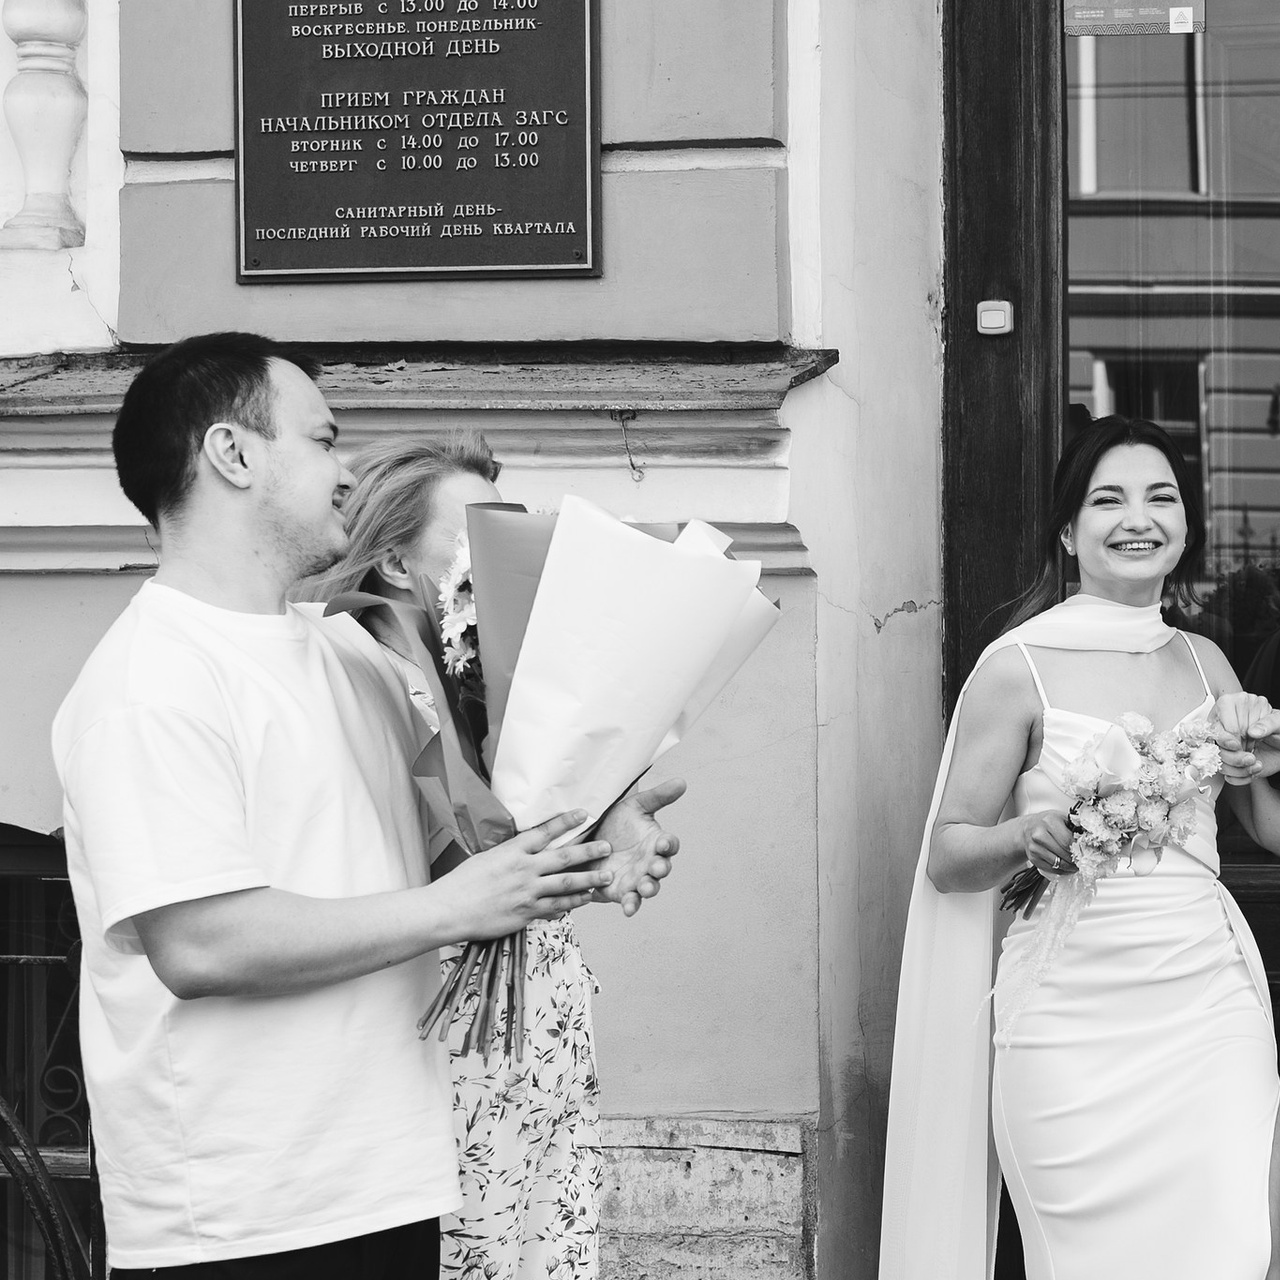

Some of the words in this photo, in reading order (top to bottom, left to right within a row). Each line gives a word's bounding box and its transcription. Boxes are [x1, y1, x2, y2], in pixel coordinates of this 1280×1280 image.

[288, 2, 363, 17] ПЕРЕРЫВ
[322, 36, 434, 59] ВЫХОДНОЙ
[445, 38, 500, 58] ДЕНЬ
[321, 91, 390, 108] ПРИЕМ
[403, 88, 504, 107] ГРАЖДАН
[260, 114, 410, 133] НАЧАЛЬНИКОМ
[421, 111, 503, 130] ОТДЕЛА
[515, 110, 568, 125] ЗАГС
[291, 139, 363, 152] ВТОРНИК
[401, 133, 443, 149] 14.00
[495, 131, 539, 147] 17.00
[289, 159, 358, 173] ЧЕТВЕРГ
[401, 154, 443, 170] 10.00
[494, 152, 539, 167] 13.00
[335, 202, 444, 219] САНИТАРНЫЙ
[255, 223, 350, 241] ПОСЛЕДНИЙ
[360, 222, 431, 238] РАБОЧИЙ
[439, 223, 483, 238] ДЕНЬ
[492, 221, 576, 235] КВАРТАЛА
